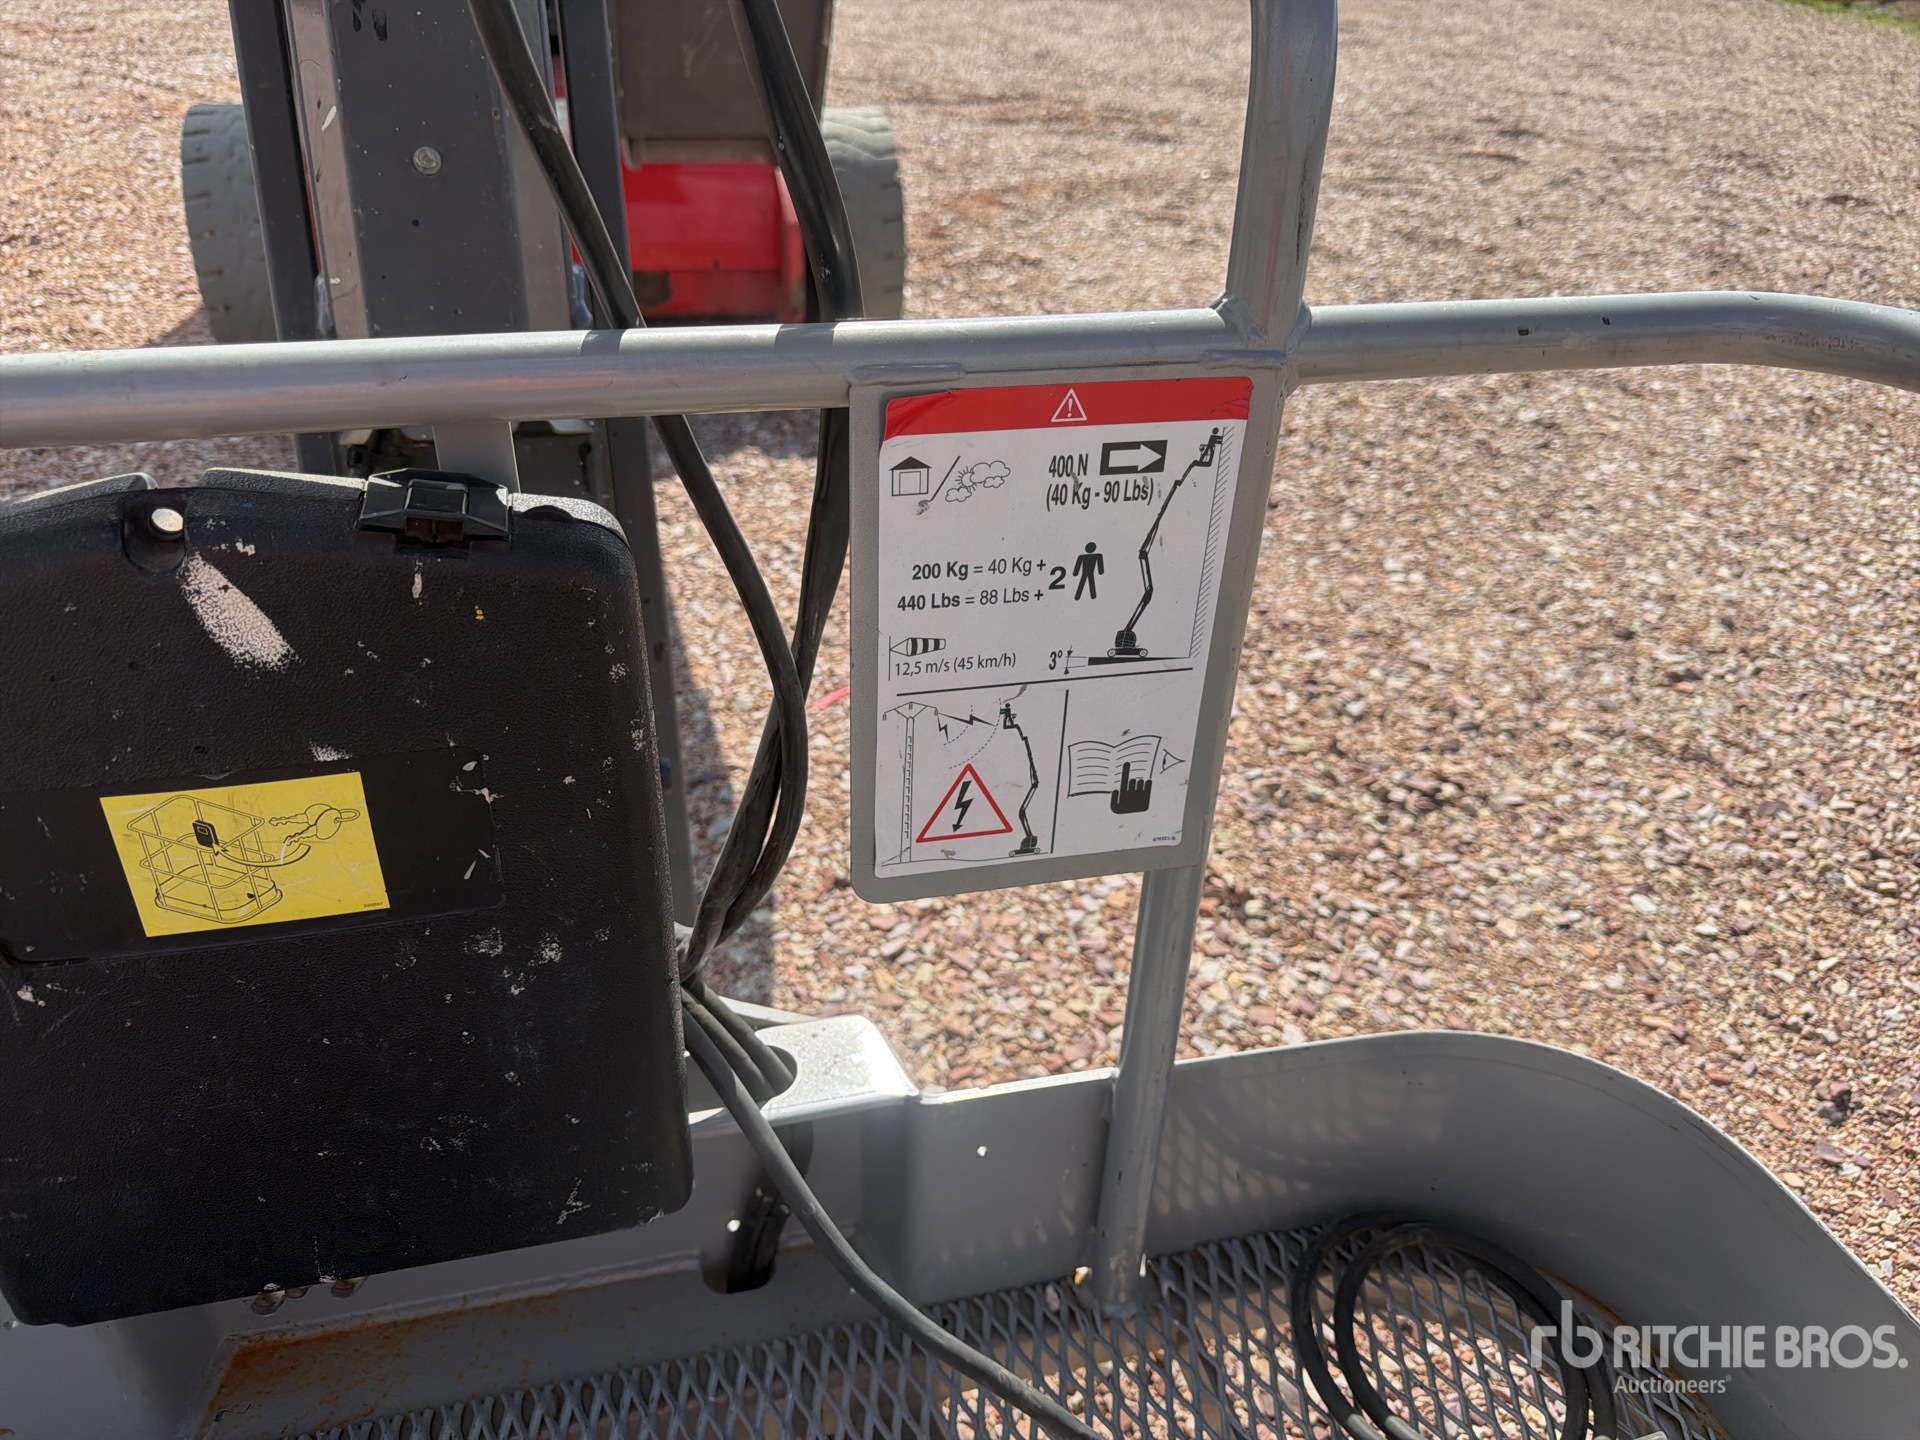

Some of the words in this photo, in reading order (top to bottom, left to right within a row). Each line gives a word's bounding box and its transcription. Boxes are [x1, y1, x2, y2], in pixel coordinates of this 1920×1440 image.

[1048, 454, 1074, 478] 400
[1077, 453, 1089, 476] N
[1046, 483, 1068, 512] (40
[1072, 482, 1091, 510] Kg
[1103, 480, 1120, 503] 90
[1123, 478, 1154, 506] Lbs)
[912, 562, 941, 580] 200
[946, 560, 969, 580] Kg
[973, 564, 983, 574] =
[988, 558, 1007, 575] 40
[1011, 556, 1032, 576] Kg
[1036, 559, 1047, 571] +
[1048, 566, 1067, 590] 2
[897, 594, 926, 611] 440
[931, 592, 961, 609] Lbs
[965, 596, 975, 605] =
[979, 589, 999, 606] 88
[1003, 587, 1030, 604] Lbs
[1034, 589, 1044, 601] +
[895, 661, 922, 677] 12,5
[925, 658, 950, 674] m/s
[953, 656, 974, 674] (45
[977, 652, 1016, 670] km/h)
